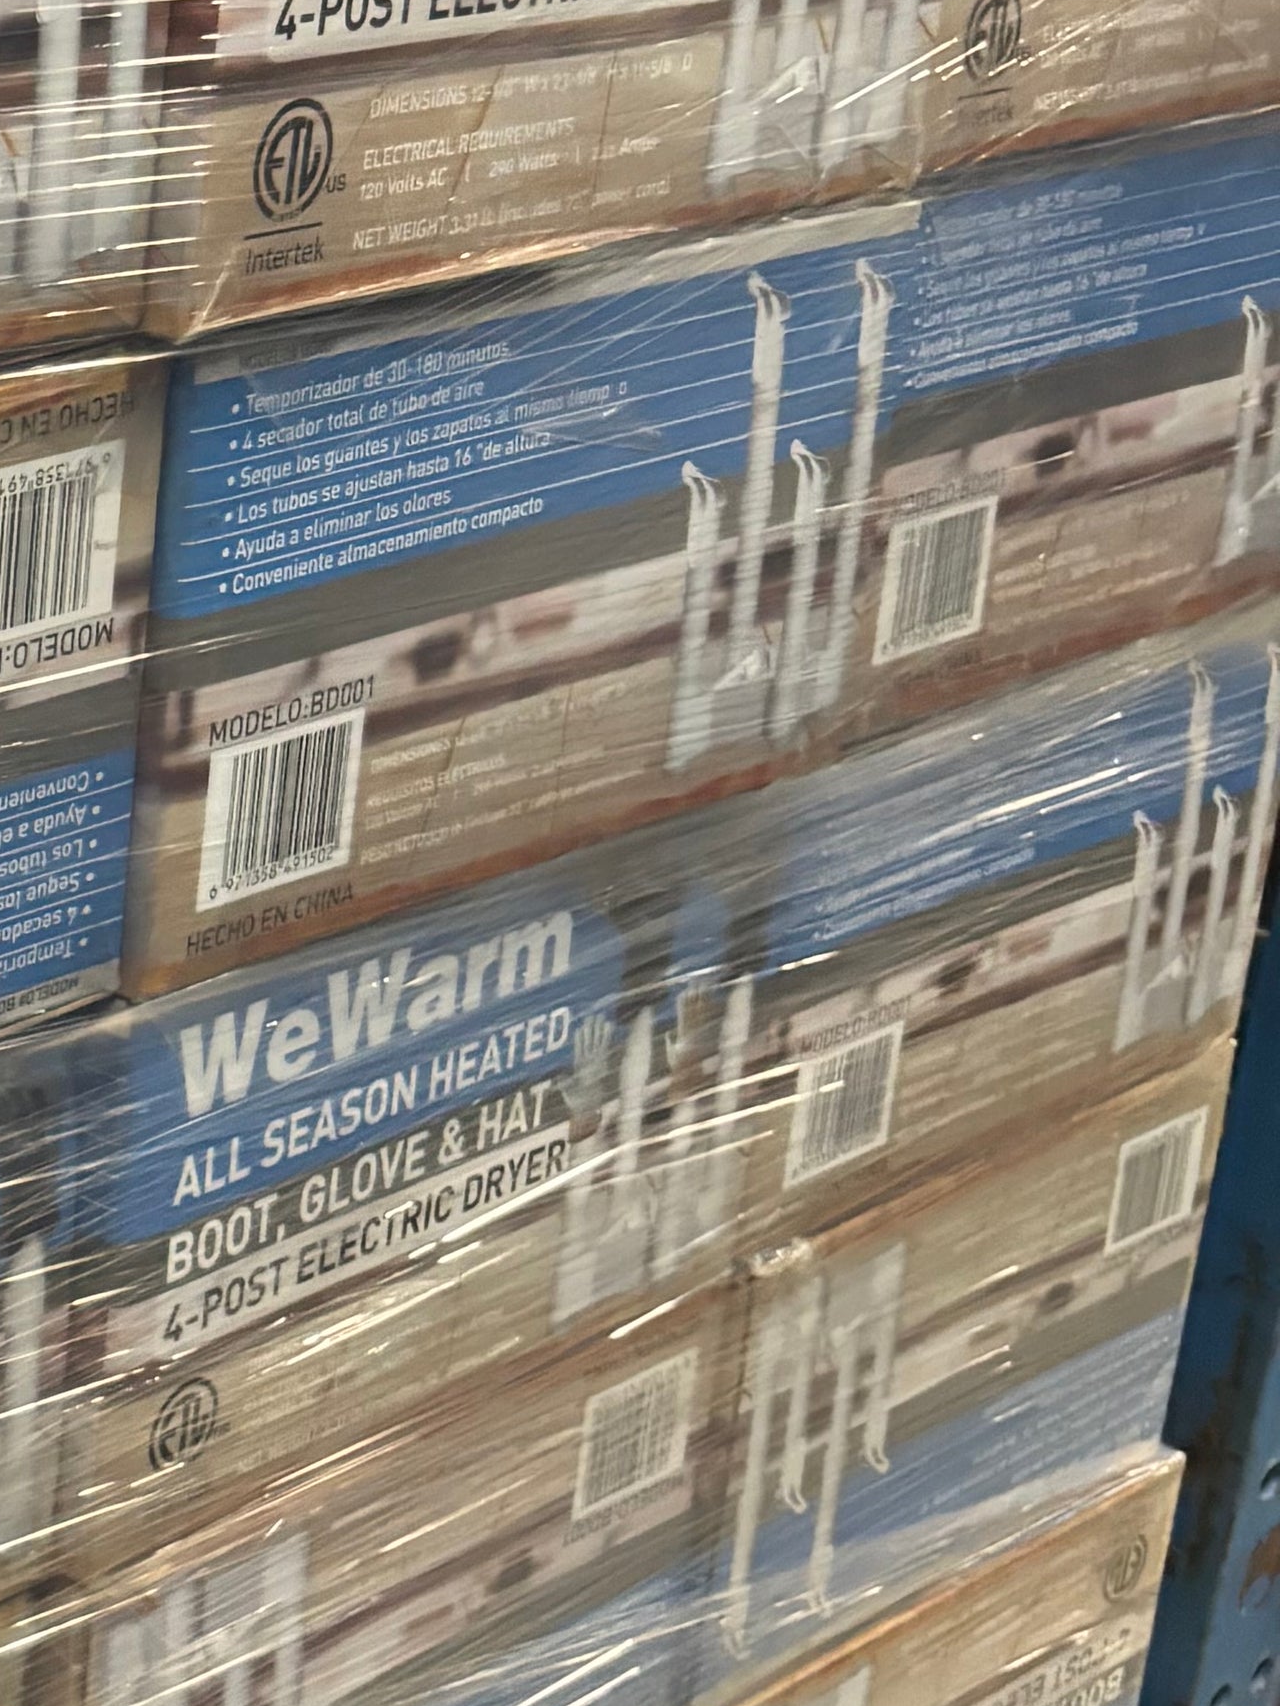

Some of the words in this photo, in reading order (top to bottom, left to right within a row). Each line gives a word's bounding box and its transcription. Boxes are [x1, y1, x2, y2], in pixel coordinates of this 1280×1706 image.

[209, 675, 376, 746] MODELO:BD001
[171, 1136, 252, 1207] ALL
[260, 1063, 417, 1168] SEASON
[428, 1005, 572, 1101] HEATED
[179, 909, 575, 1119] WeWarm
[163, 1257, 285, 1343] 4-POST
[295, 1184, 455, 1287] ELECTRIC
[461, 1137, 567, 1212] DRYER
[164, 1198, 286, 1285] BOOT,
[298, 1142, 430, 1225] GLOVE
[438, 1116, 466, 1163] &
[477, 1082, 554, 1152] HAT
